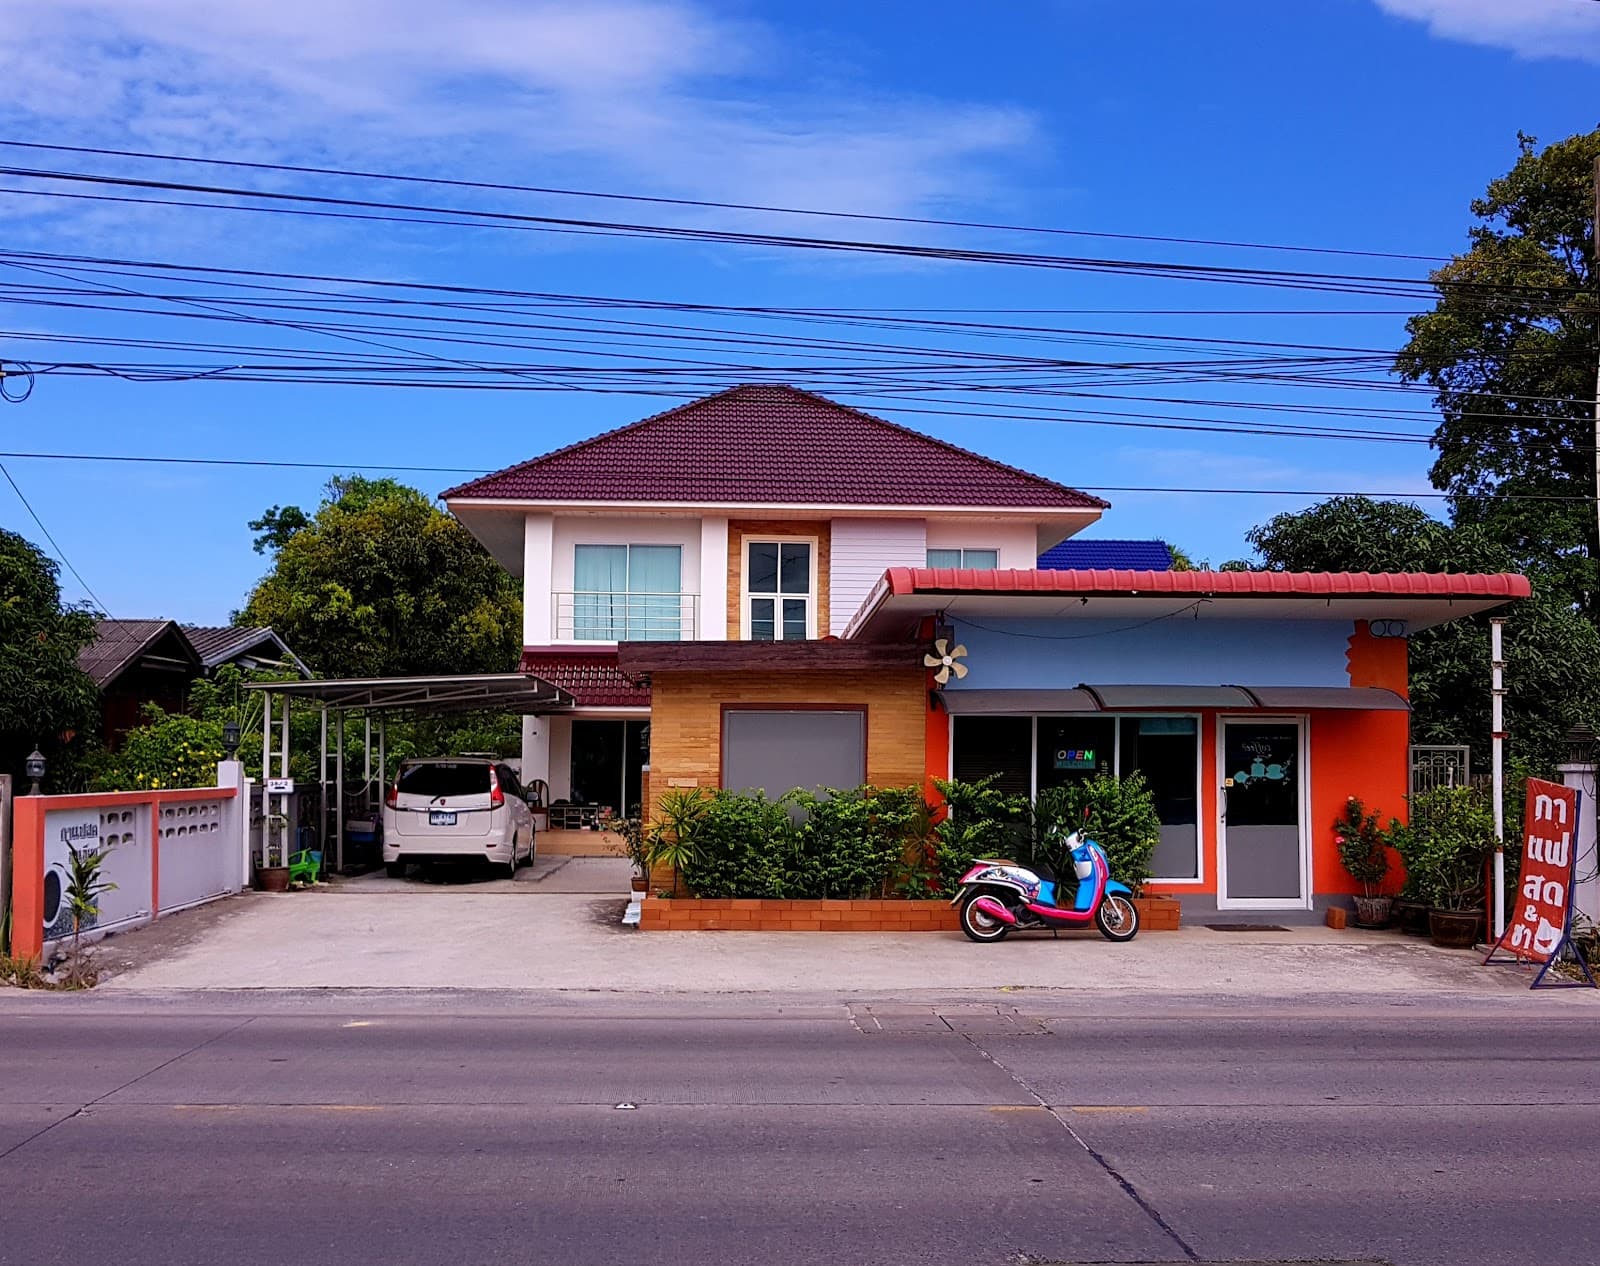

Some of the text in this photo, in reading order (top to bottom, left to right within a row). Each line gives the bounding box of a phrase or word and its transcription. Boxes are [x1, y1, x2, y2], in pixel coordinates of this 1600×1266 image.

[1057, 750, 1093, 760] OPEN
[1535, 794, 1567, 825] กา
[1527, 832, 1570, 868] แฟ
[1523, 874, 1564, 907] สด
[1524, 904, 1538, 922] &
[1511, 923, 1533, 950] ชา
